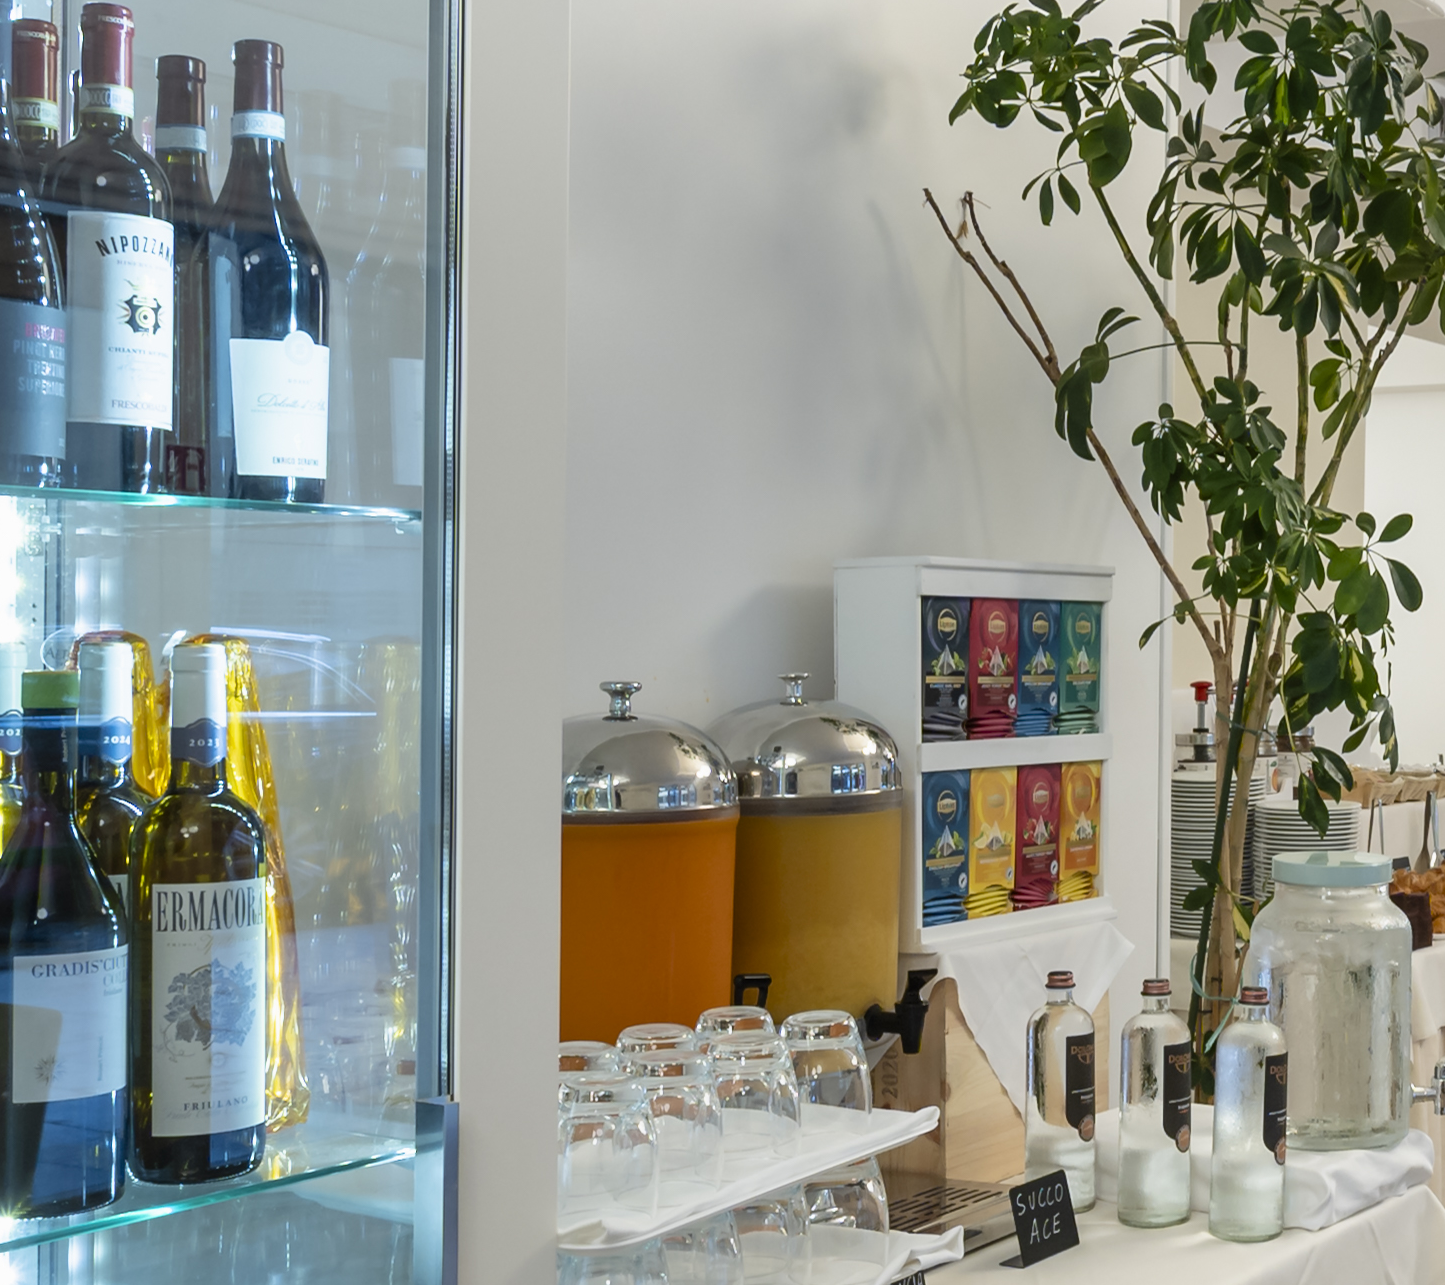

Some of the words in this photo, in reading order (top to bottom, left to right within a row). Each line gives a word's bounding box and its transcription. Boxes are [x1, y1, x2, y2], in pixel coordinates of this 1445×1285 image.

[108, 346, 146, 355] CHIANTI
[155, 887, 263, 932] ERMACORA
[31, 953, 128, 978] GRADIS'CIUT
[183, 1095, 248, 1112] FRIULANO
[1016, 1182, 1064, 1217] SUCCO
[1029, 1212, 1062, 1245] ACE
